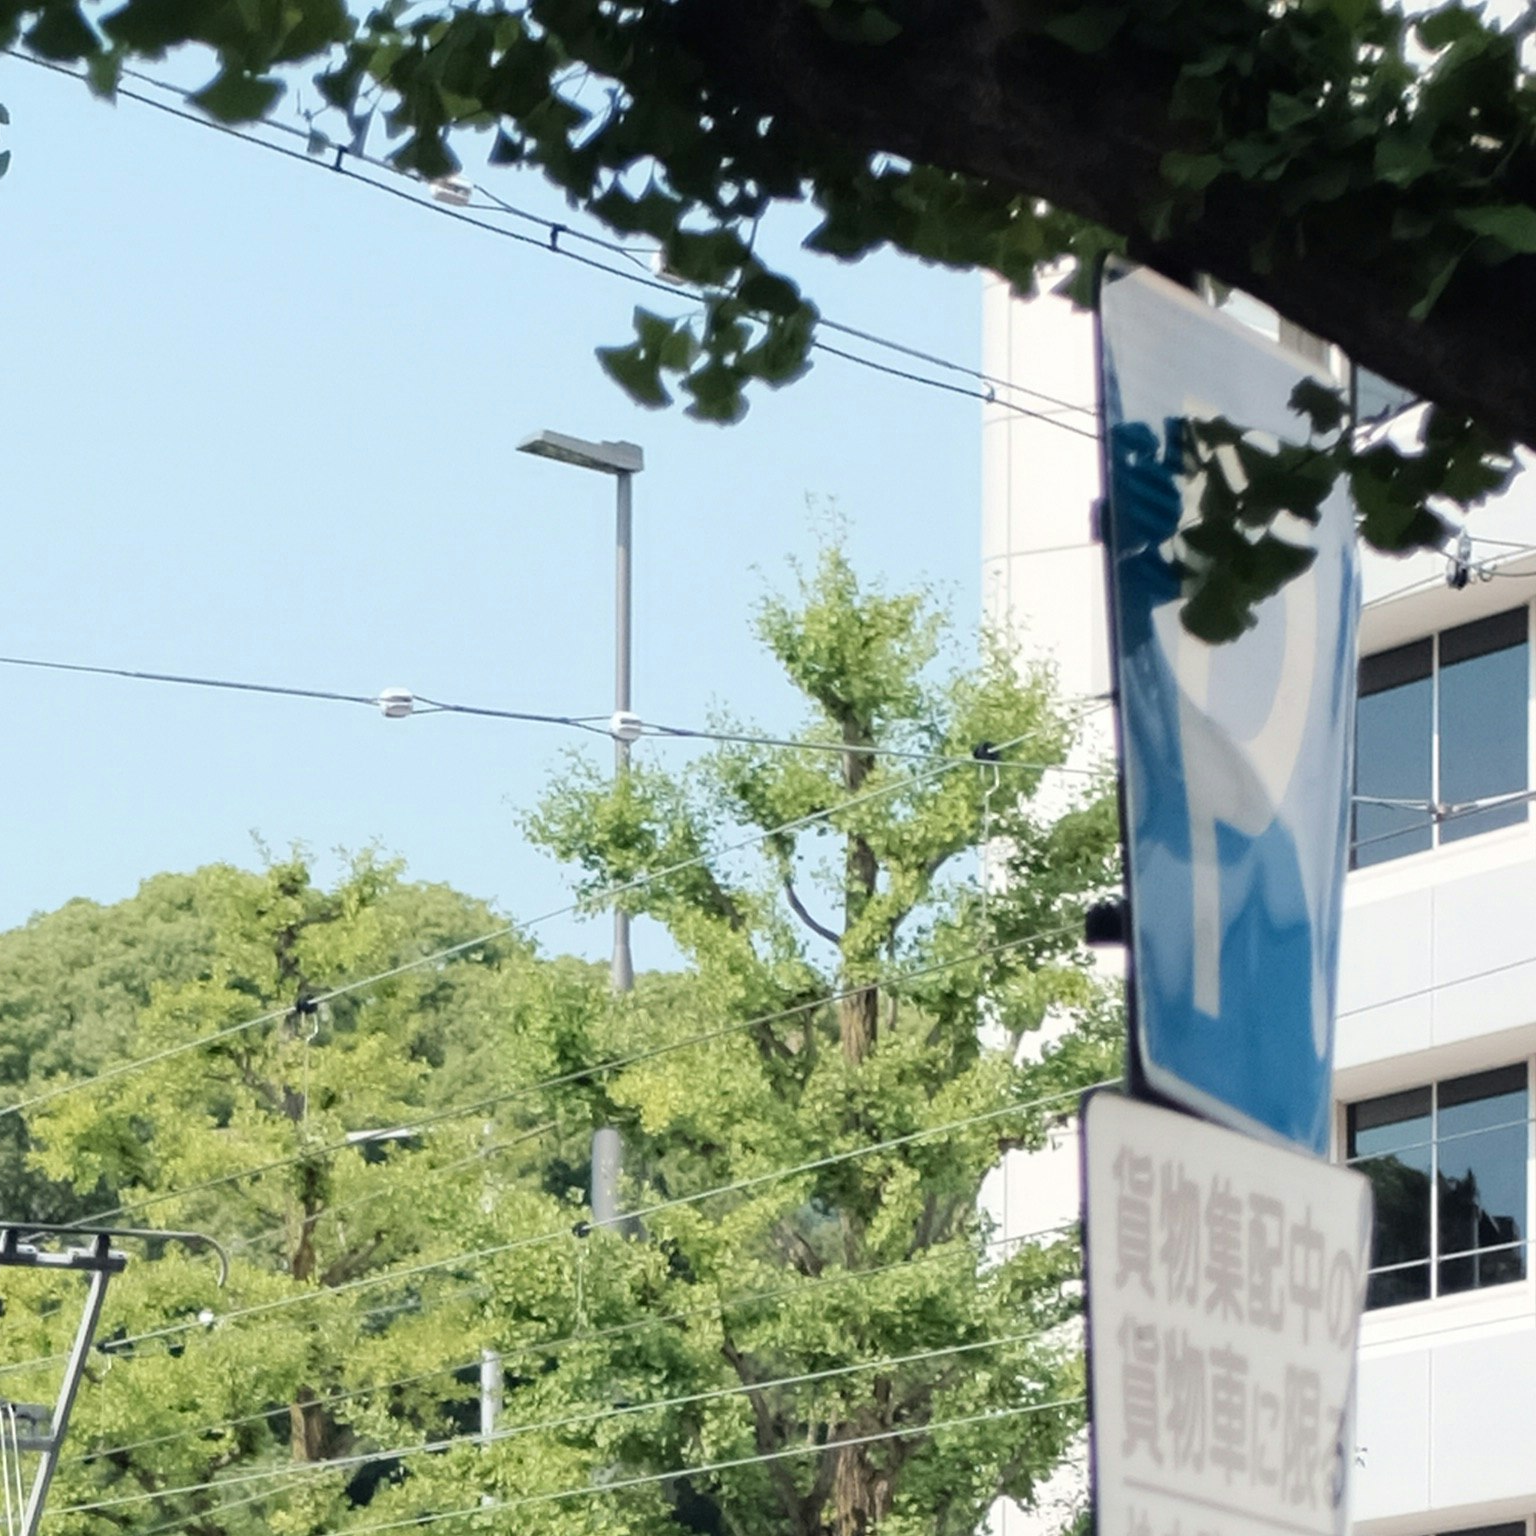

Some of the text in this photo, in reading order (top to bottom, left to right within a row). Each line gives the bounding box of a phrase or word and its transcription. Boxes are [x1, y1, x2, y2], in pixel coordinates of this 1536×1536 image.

[1112, 1143, 1360, 1355] 貨物集配中の
[1116, 1316, 1346, 1511] 貨物車に限る
